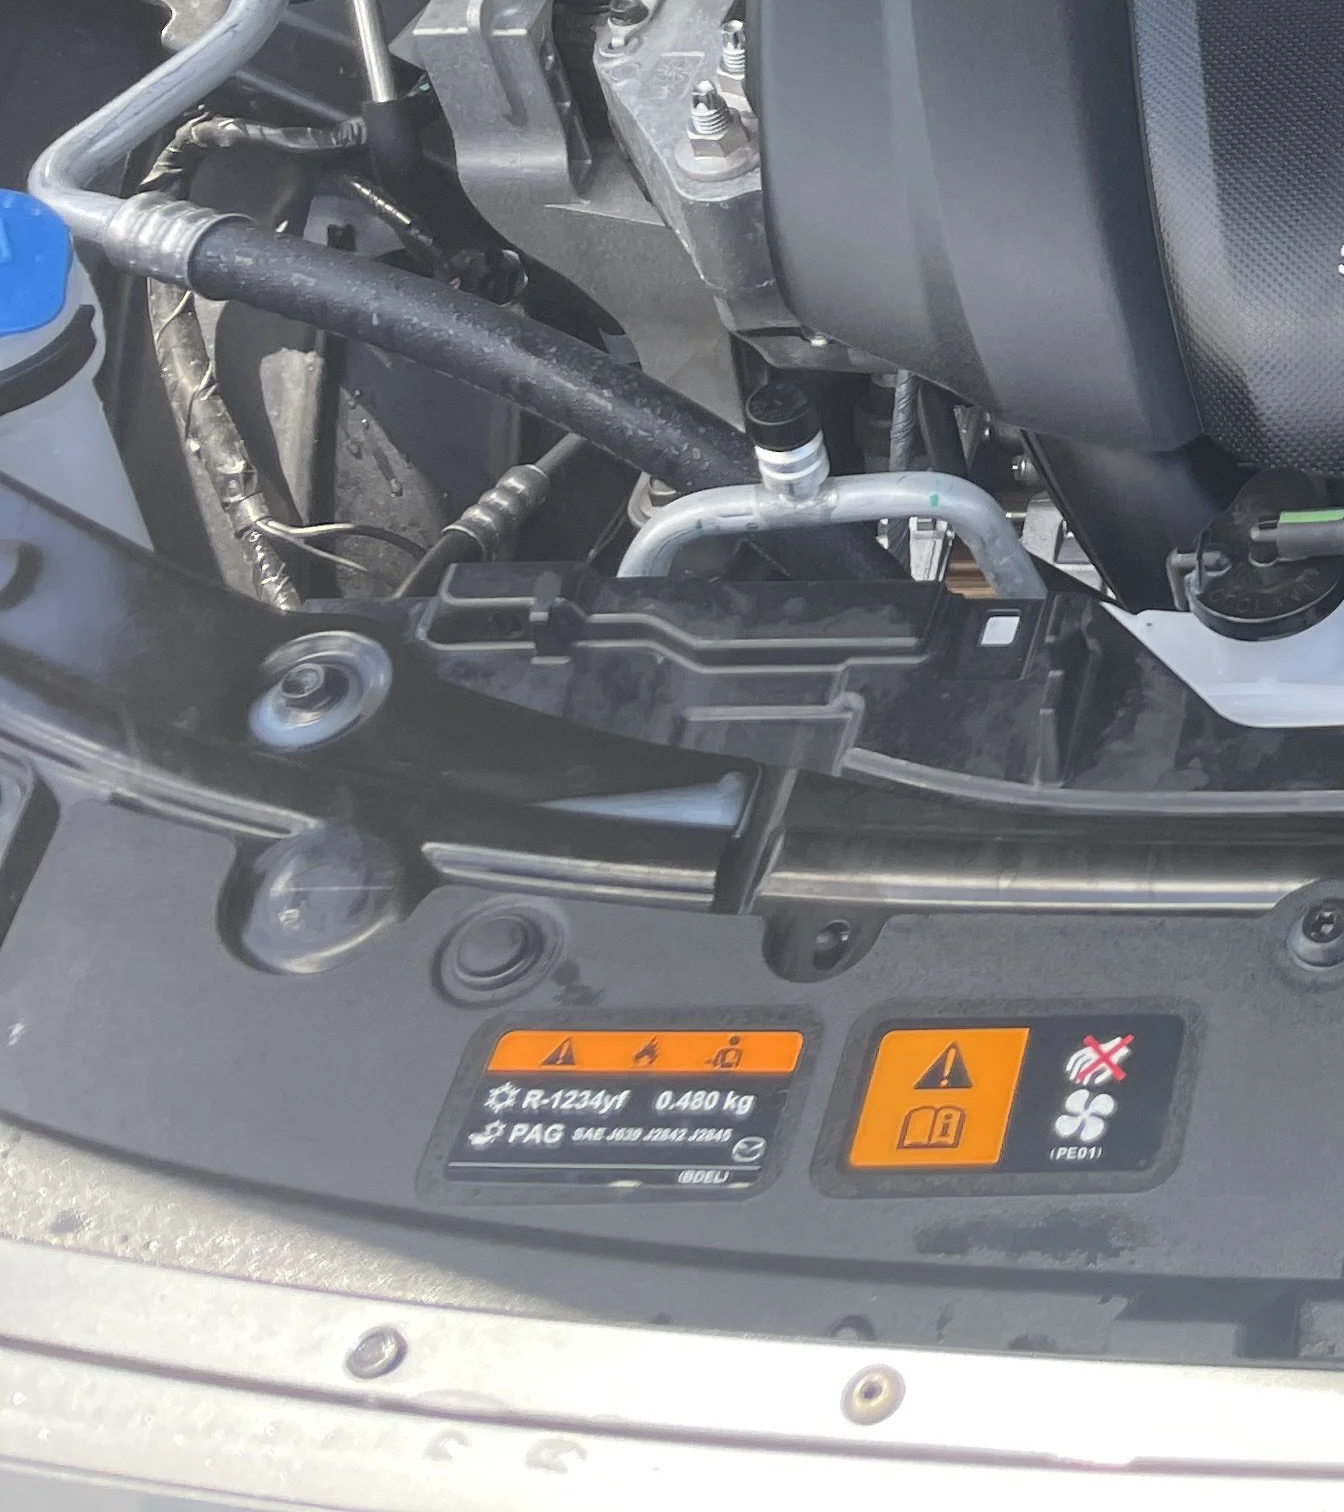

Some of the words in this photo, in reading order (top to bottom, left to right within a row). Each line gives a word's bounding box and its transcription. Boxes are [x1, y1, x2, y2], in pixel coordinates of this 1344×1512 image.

[522, 1089, 631, 1115] R-1234yf
[655, 1090, 717, 1112] 0.480
[723, 1090, 755, 1116] kg
[508, 1122, 565, 1144] PAG
[571, 1127, 606, 1142] SAE
[642, 1127, 690, 1142] J2842
[1049, 1146, 1103, 1161] (PE01)
